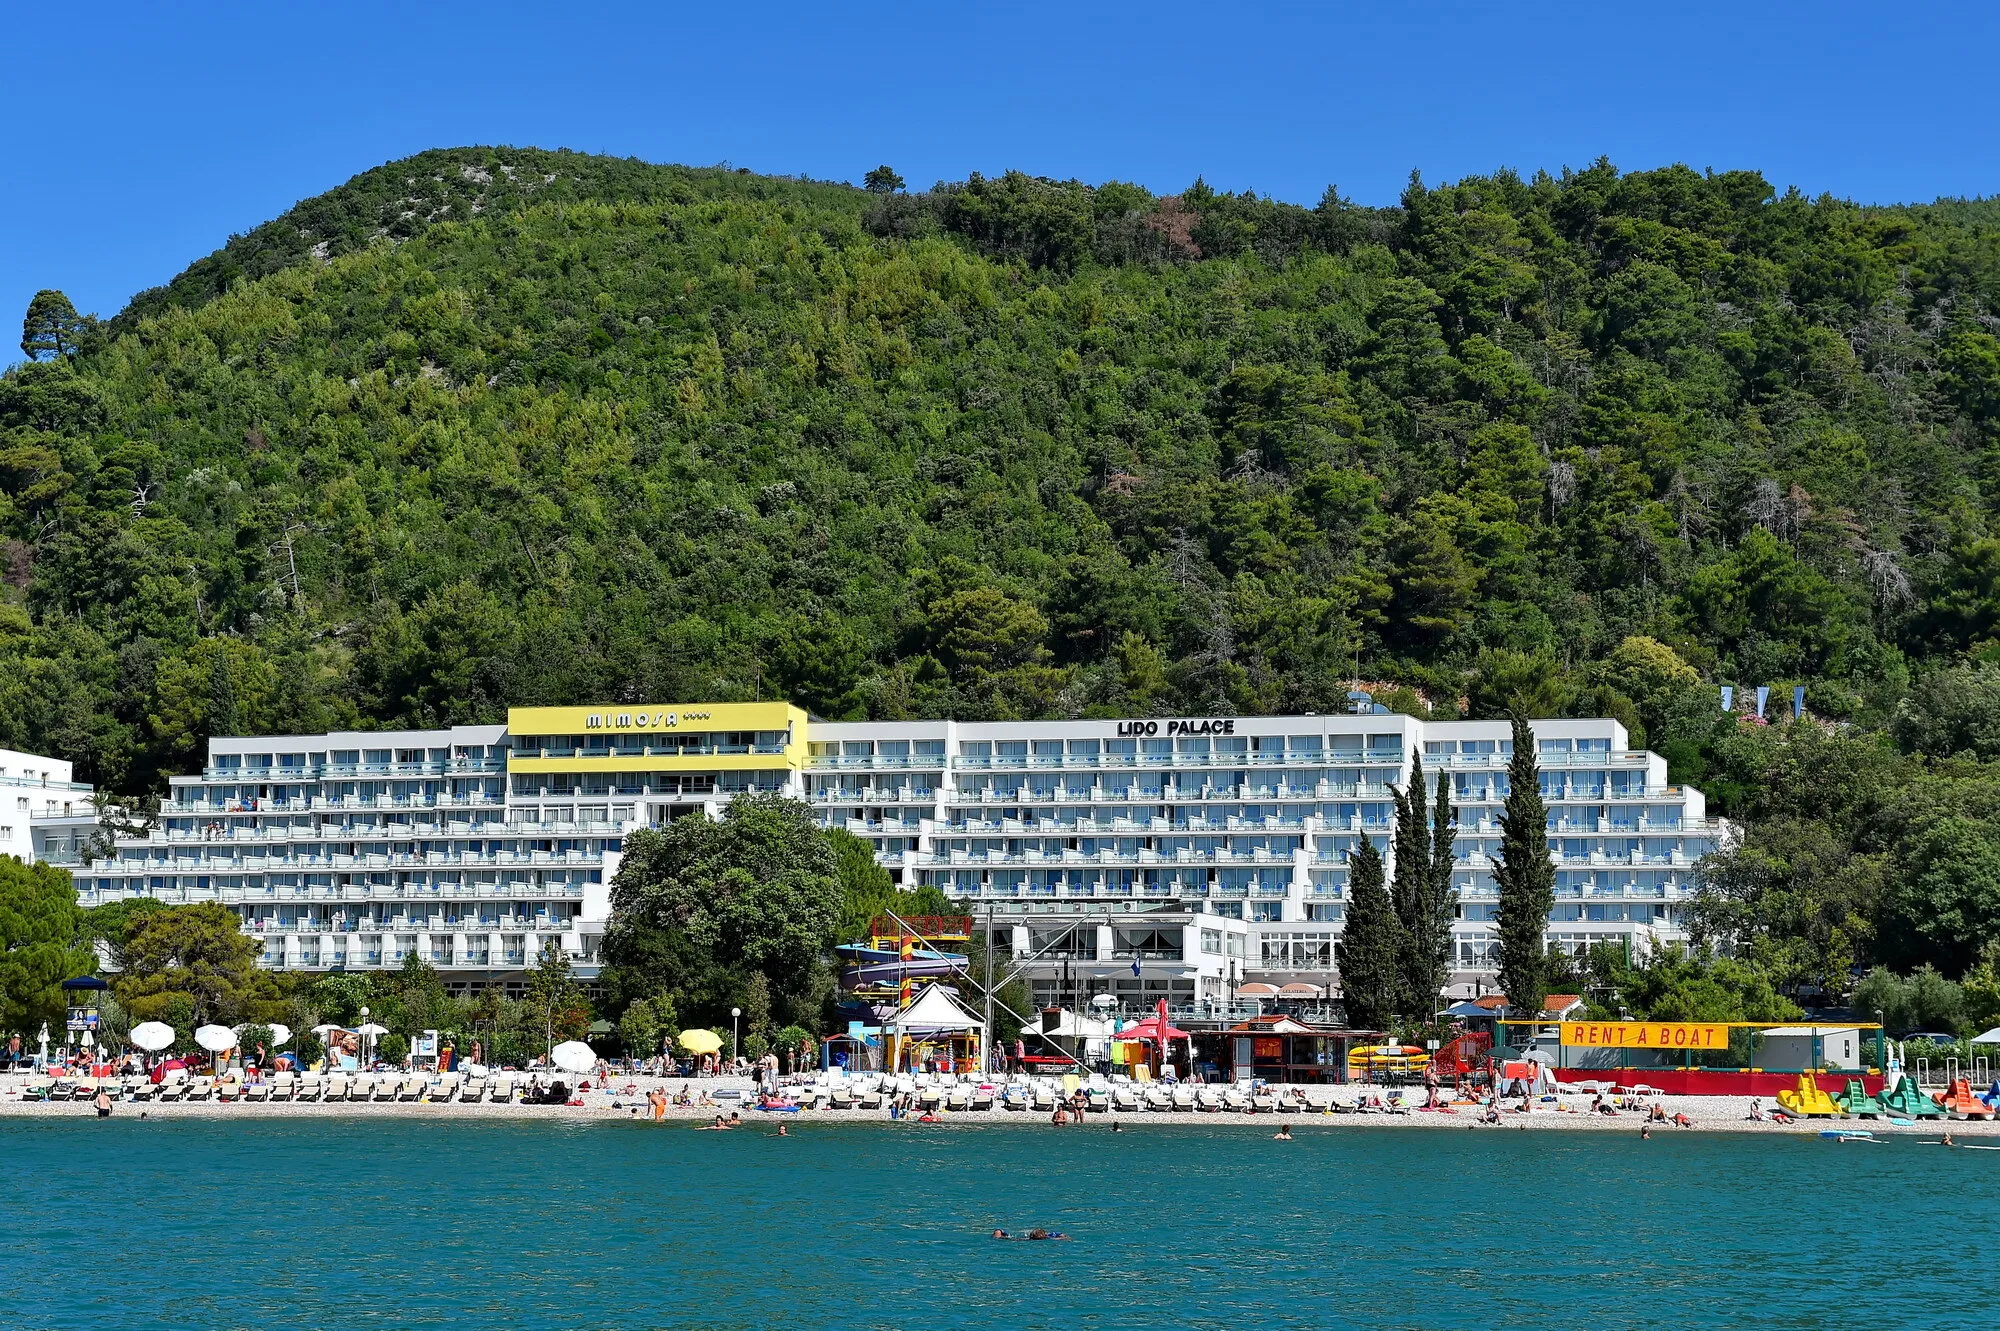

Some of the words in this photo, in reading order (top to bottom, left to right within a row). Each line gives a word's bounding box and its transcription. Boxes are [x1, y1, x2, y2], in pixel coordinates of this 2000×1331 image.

[586, 712, 678, 729] MIMOSA
[1117, 721, 1158, 737] LIDO
[1167, 720, 1235, 736] PALACE
[1574, 1026, 1626, 1044] RENT
[1637, 1028, 1647, 1045] A
[1660, 1028, 1714, 1046] BOAT
